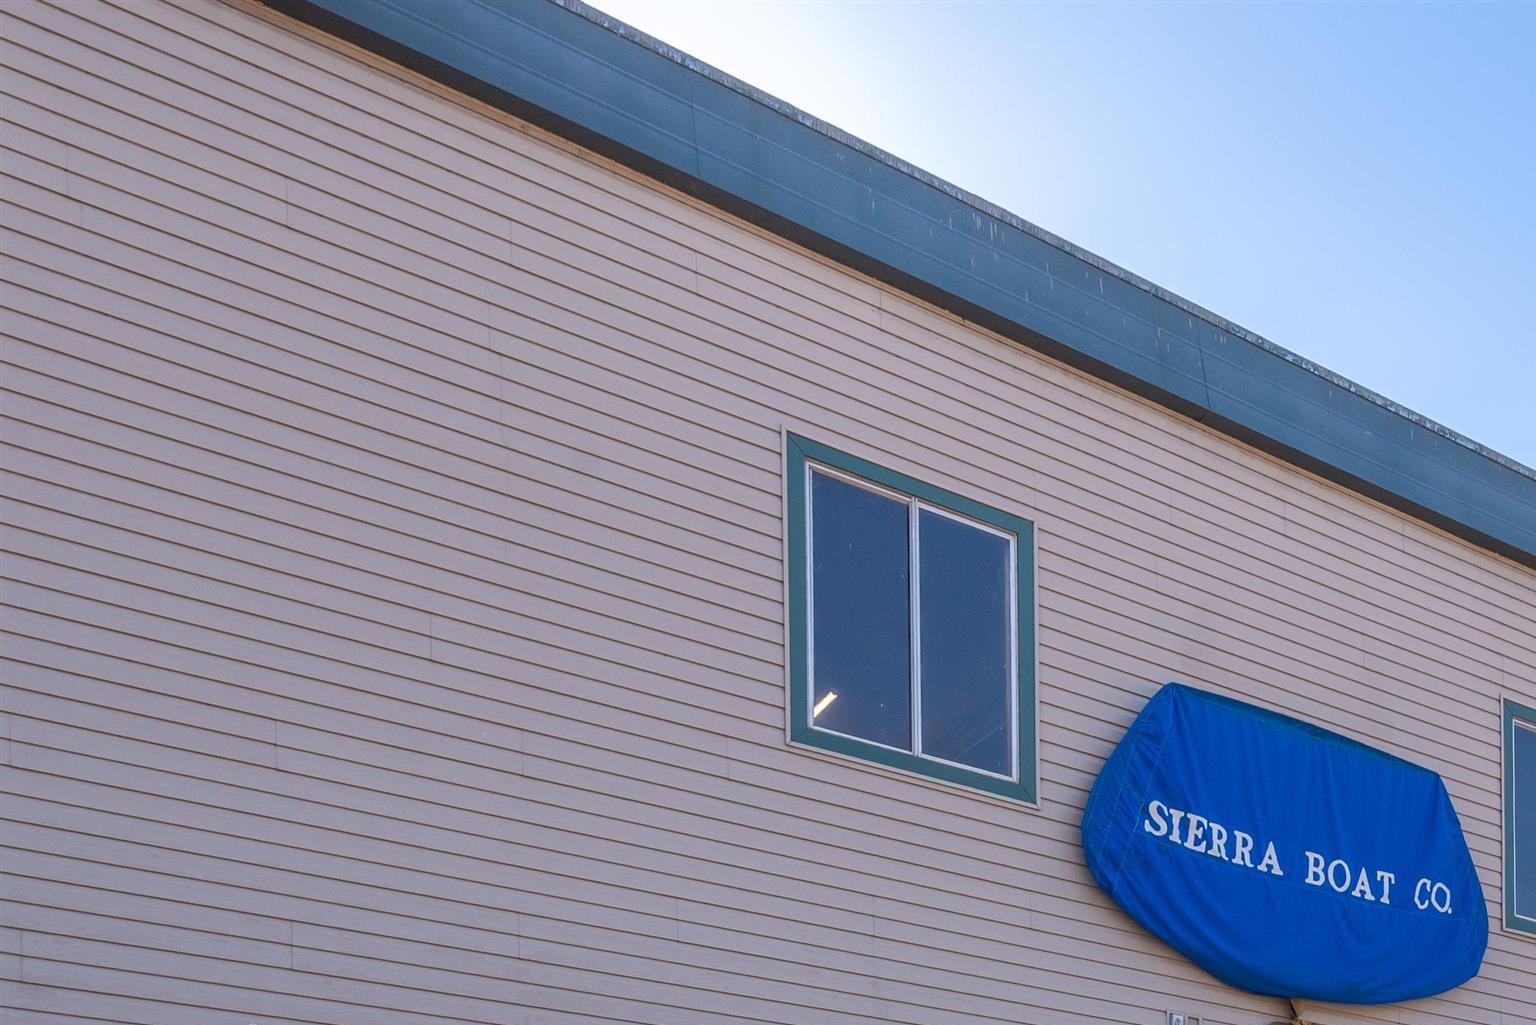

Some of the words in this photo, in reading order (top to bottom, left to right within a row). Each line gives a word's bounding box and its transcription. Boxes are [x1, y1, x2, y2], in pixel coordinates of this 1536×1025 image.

[1144, 799, 1284, 876] SIERRA
[1304, 851, 1396, 905] BOAT
[1413, 877, 1453, 915] CO.
